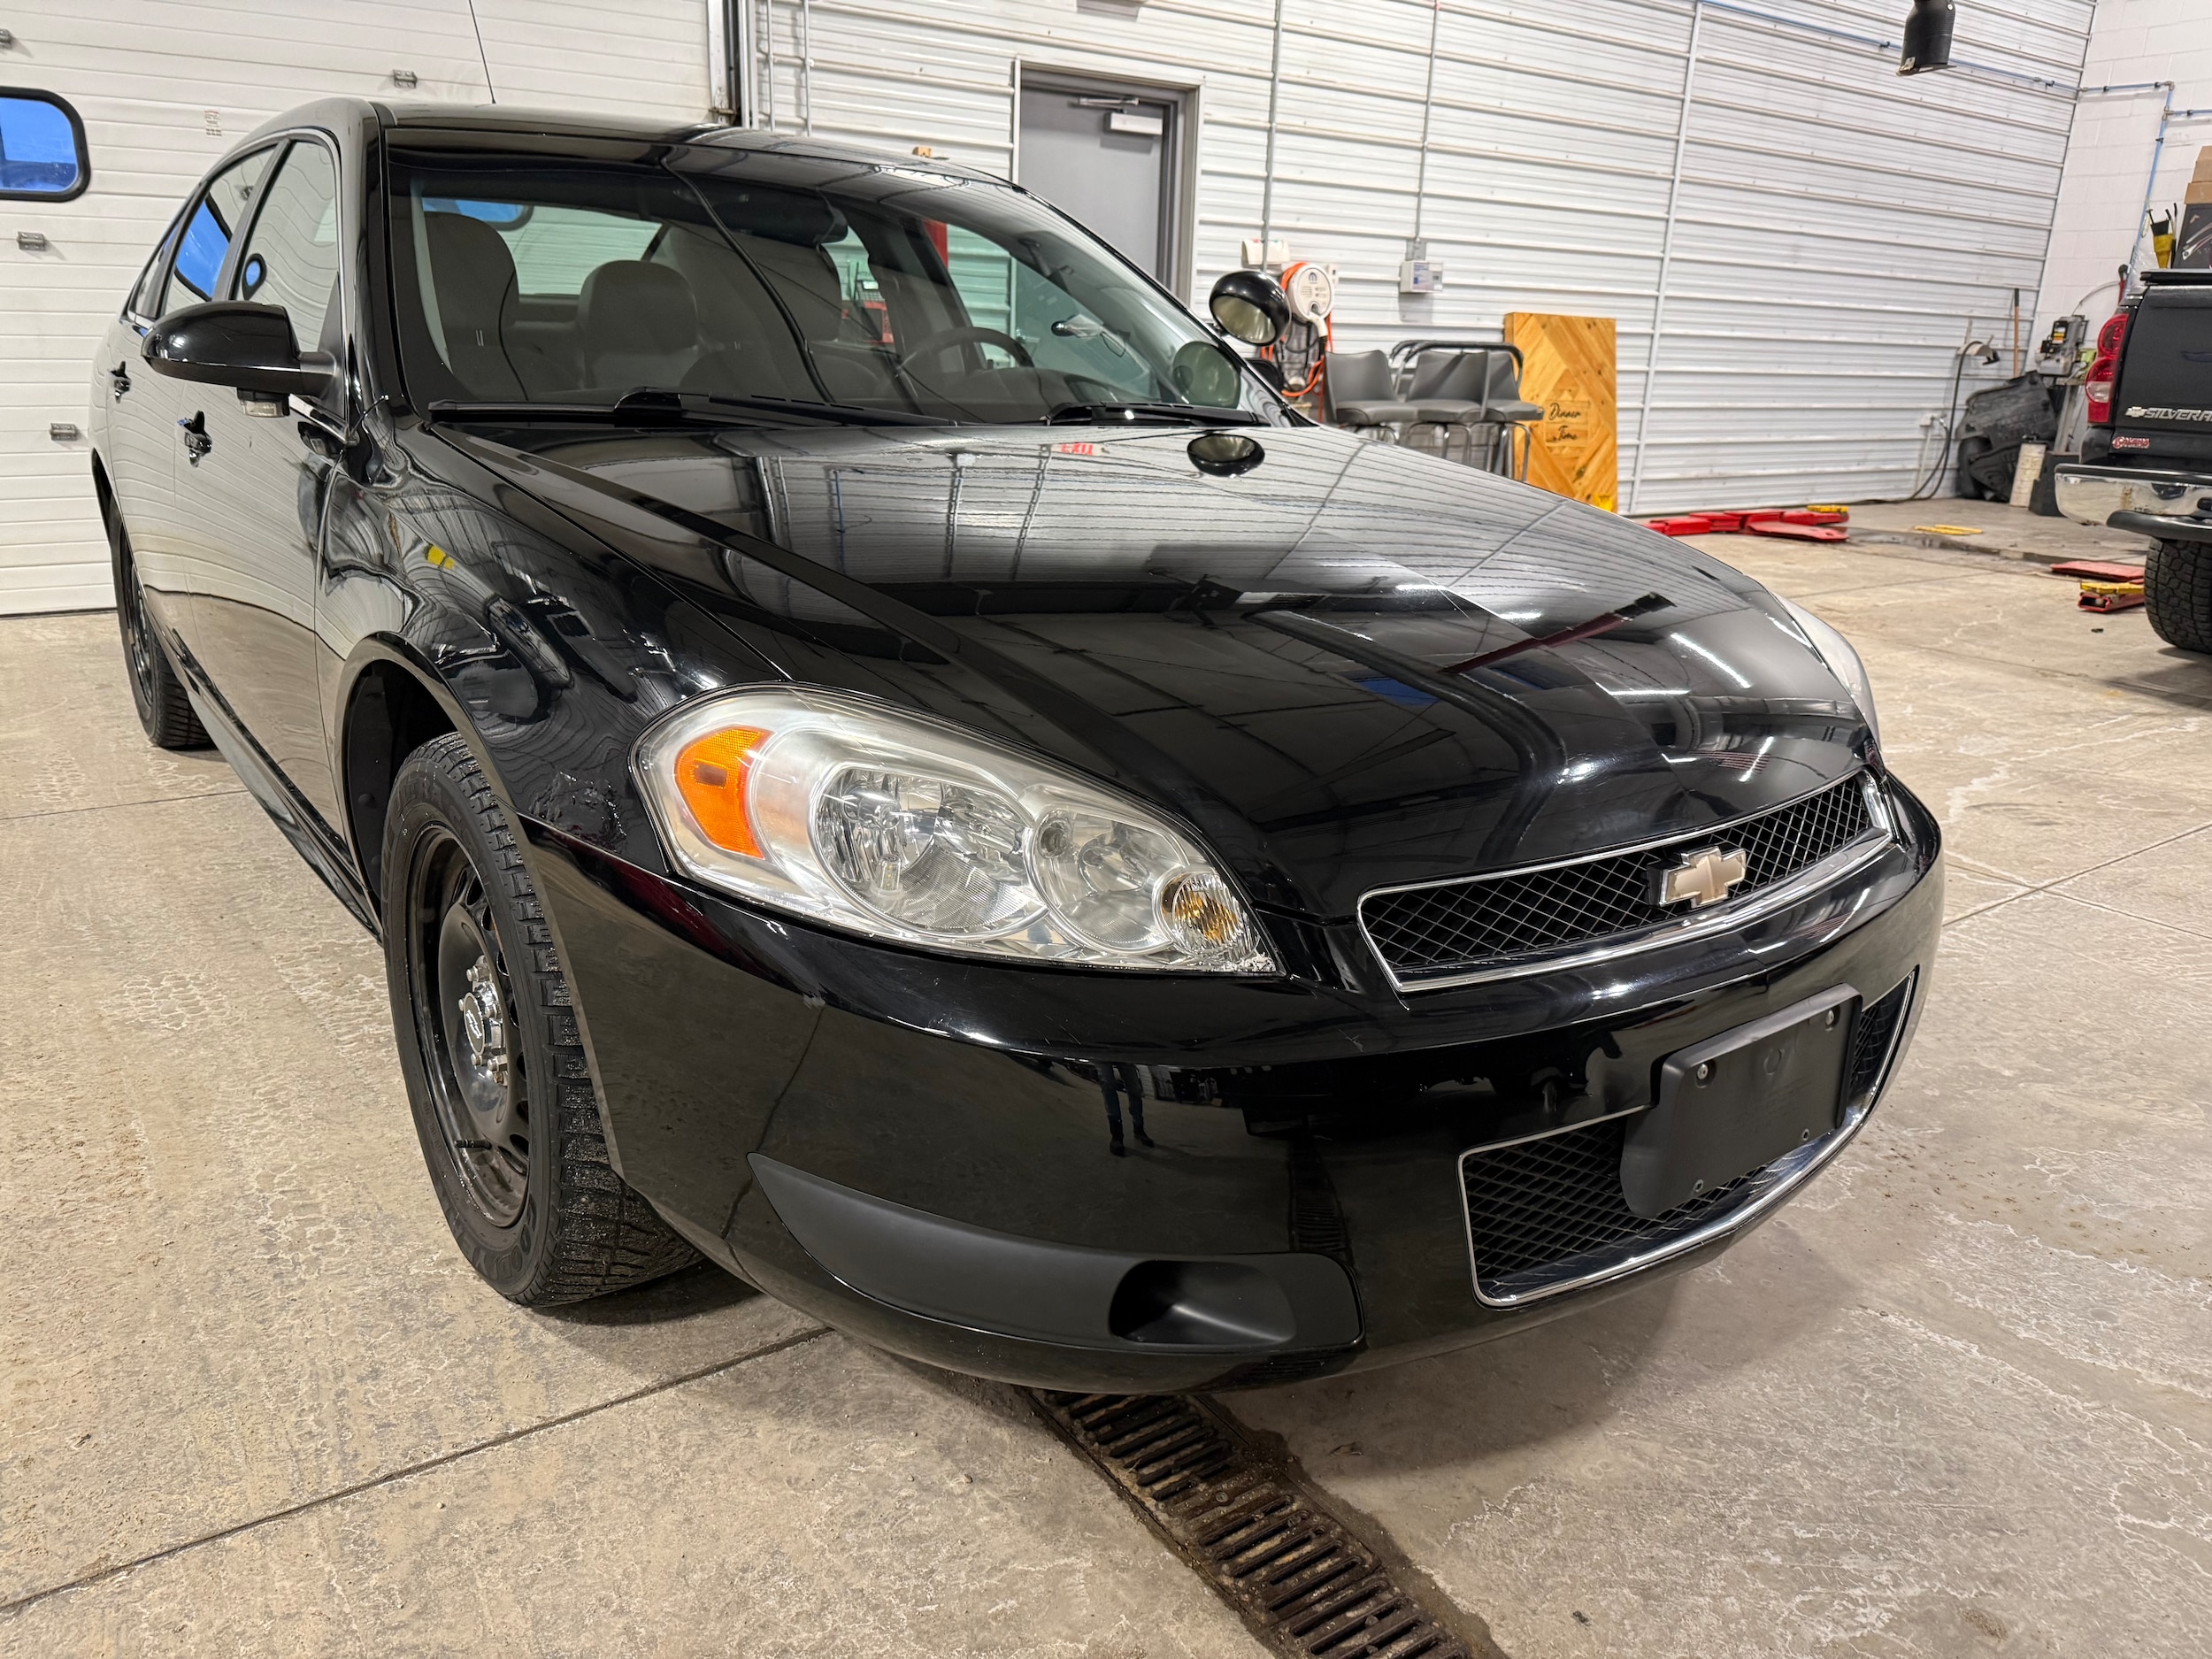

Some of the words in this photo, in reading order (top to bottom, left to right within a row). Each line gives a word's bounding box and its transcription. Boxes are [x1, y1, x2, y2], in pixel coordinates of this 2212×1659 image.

[1548, 403, 1581, 420] Dinner
[2144, 407, 2212, 422] SILVERA
[1558, 425, 1578, 440] Time
